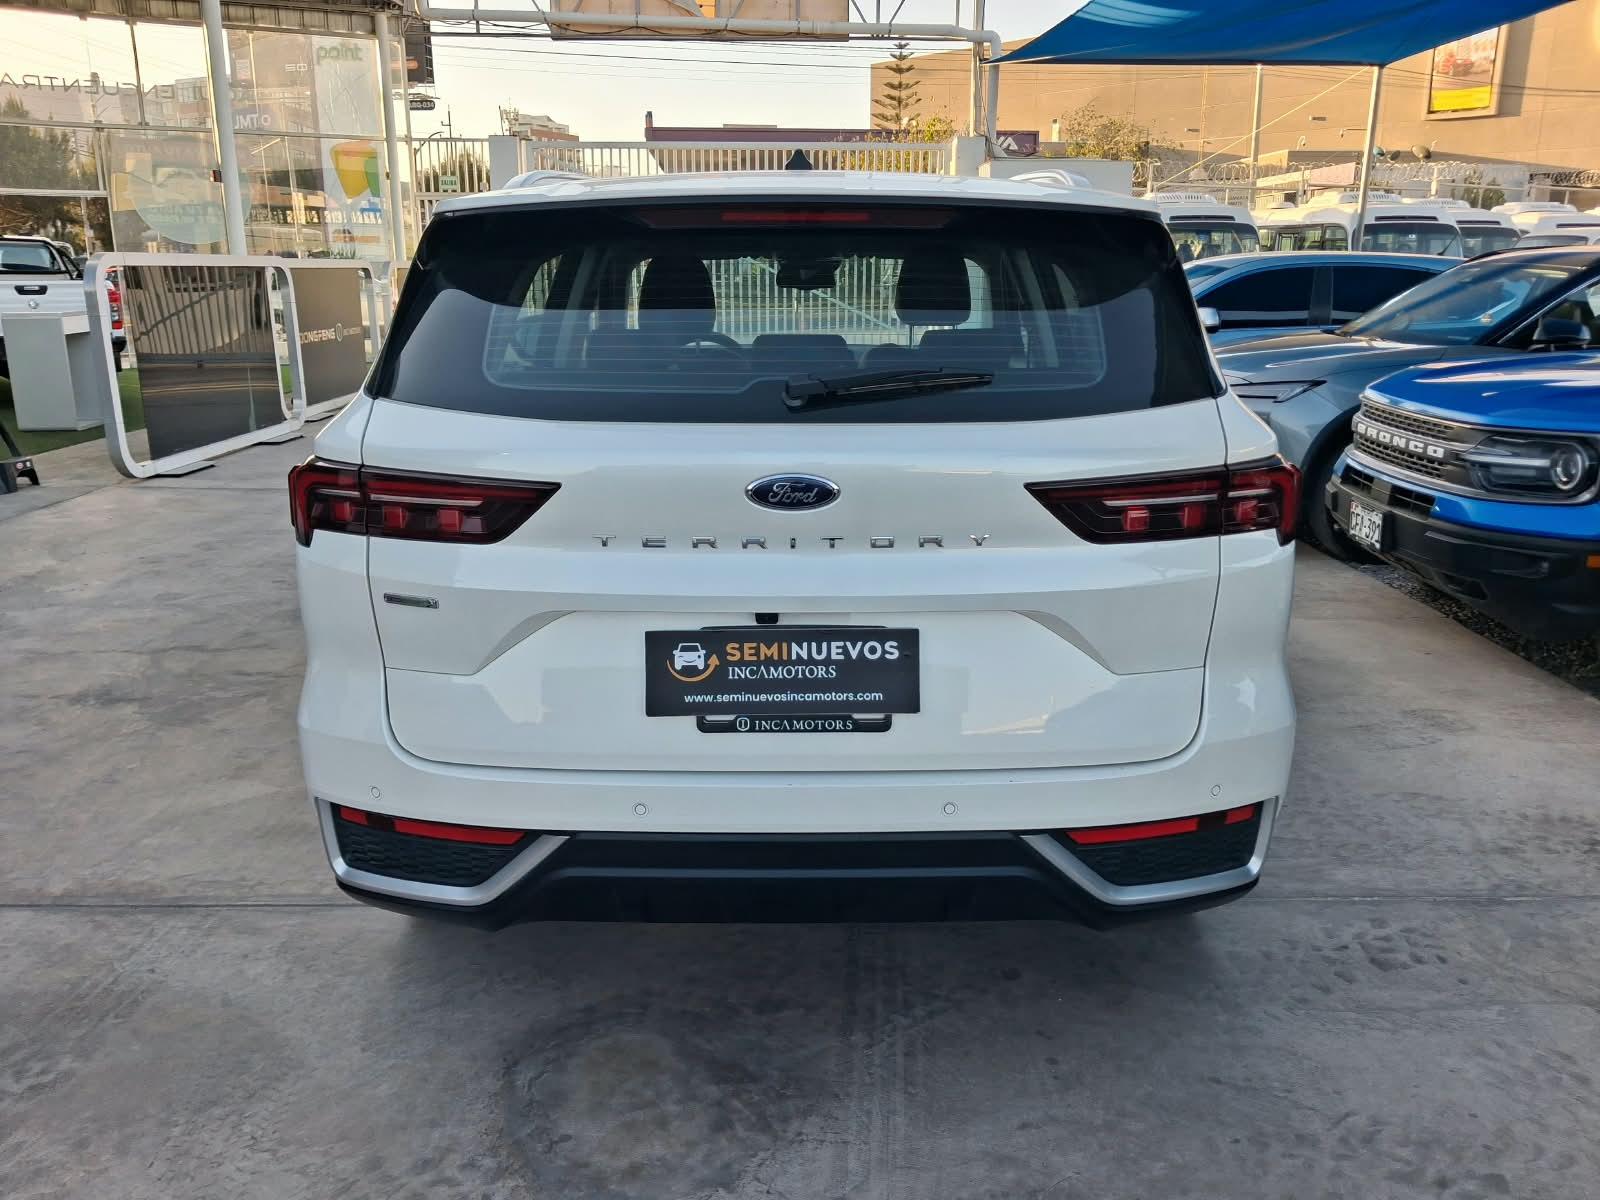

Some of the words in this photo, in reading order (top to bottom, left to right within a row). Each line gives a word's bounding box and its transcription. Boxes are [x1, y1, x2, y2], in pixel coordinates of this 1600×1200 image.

[1356, 422, 1445, 459] BRONCO
[767, 481, 819, 505] Ford
[592, 533, 991, 549] TERRITORY
[726, 640, 900, 662] SEMINUEVOS
[727, 665, 837, 680] INCAMOTORS
[684, 691, 884, 703] www.seminuevosincamotors.com
